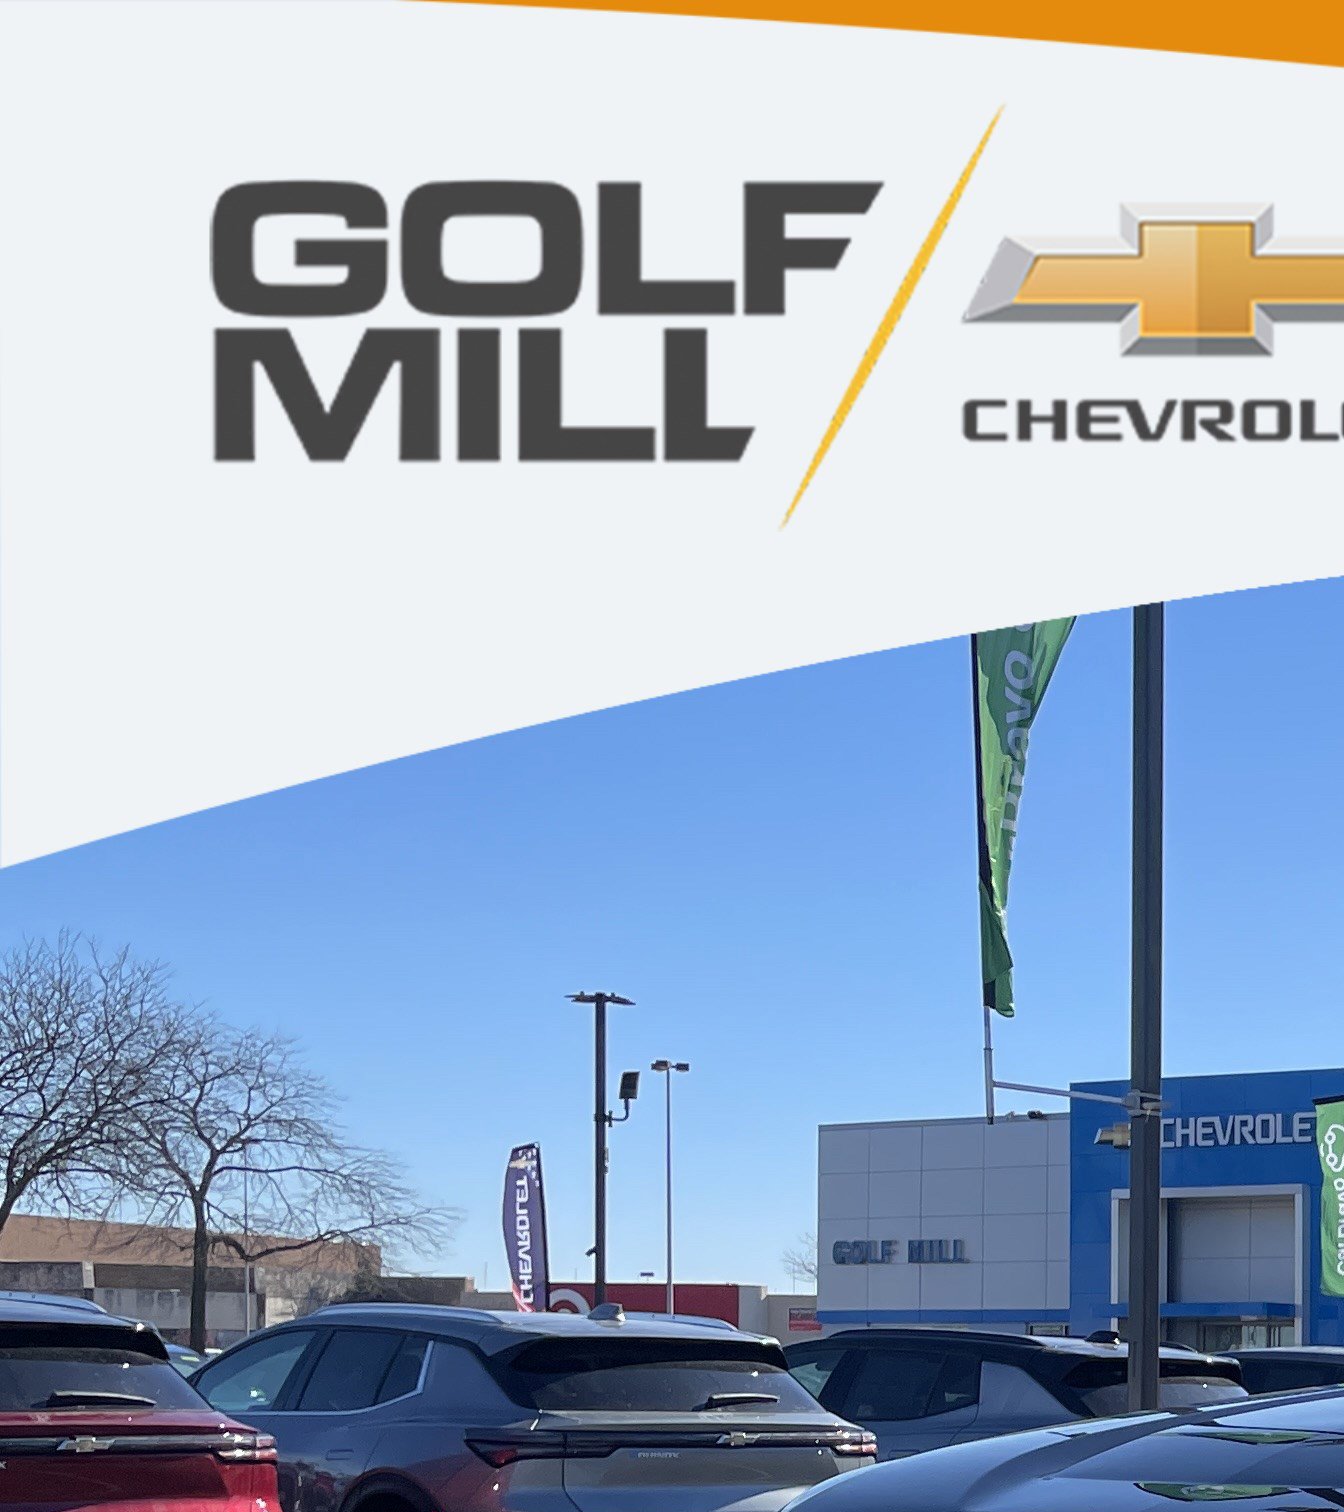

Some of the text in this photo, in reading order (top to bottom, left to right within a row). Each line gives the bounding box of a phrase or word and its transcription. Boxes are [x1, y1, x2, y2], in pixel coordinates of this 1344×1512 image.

[1160, 1110, 1316, 1148] CHEVROLE
[832, 1239, 971, 1265] GOLF MILL
